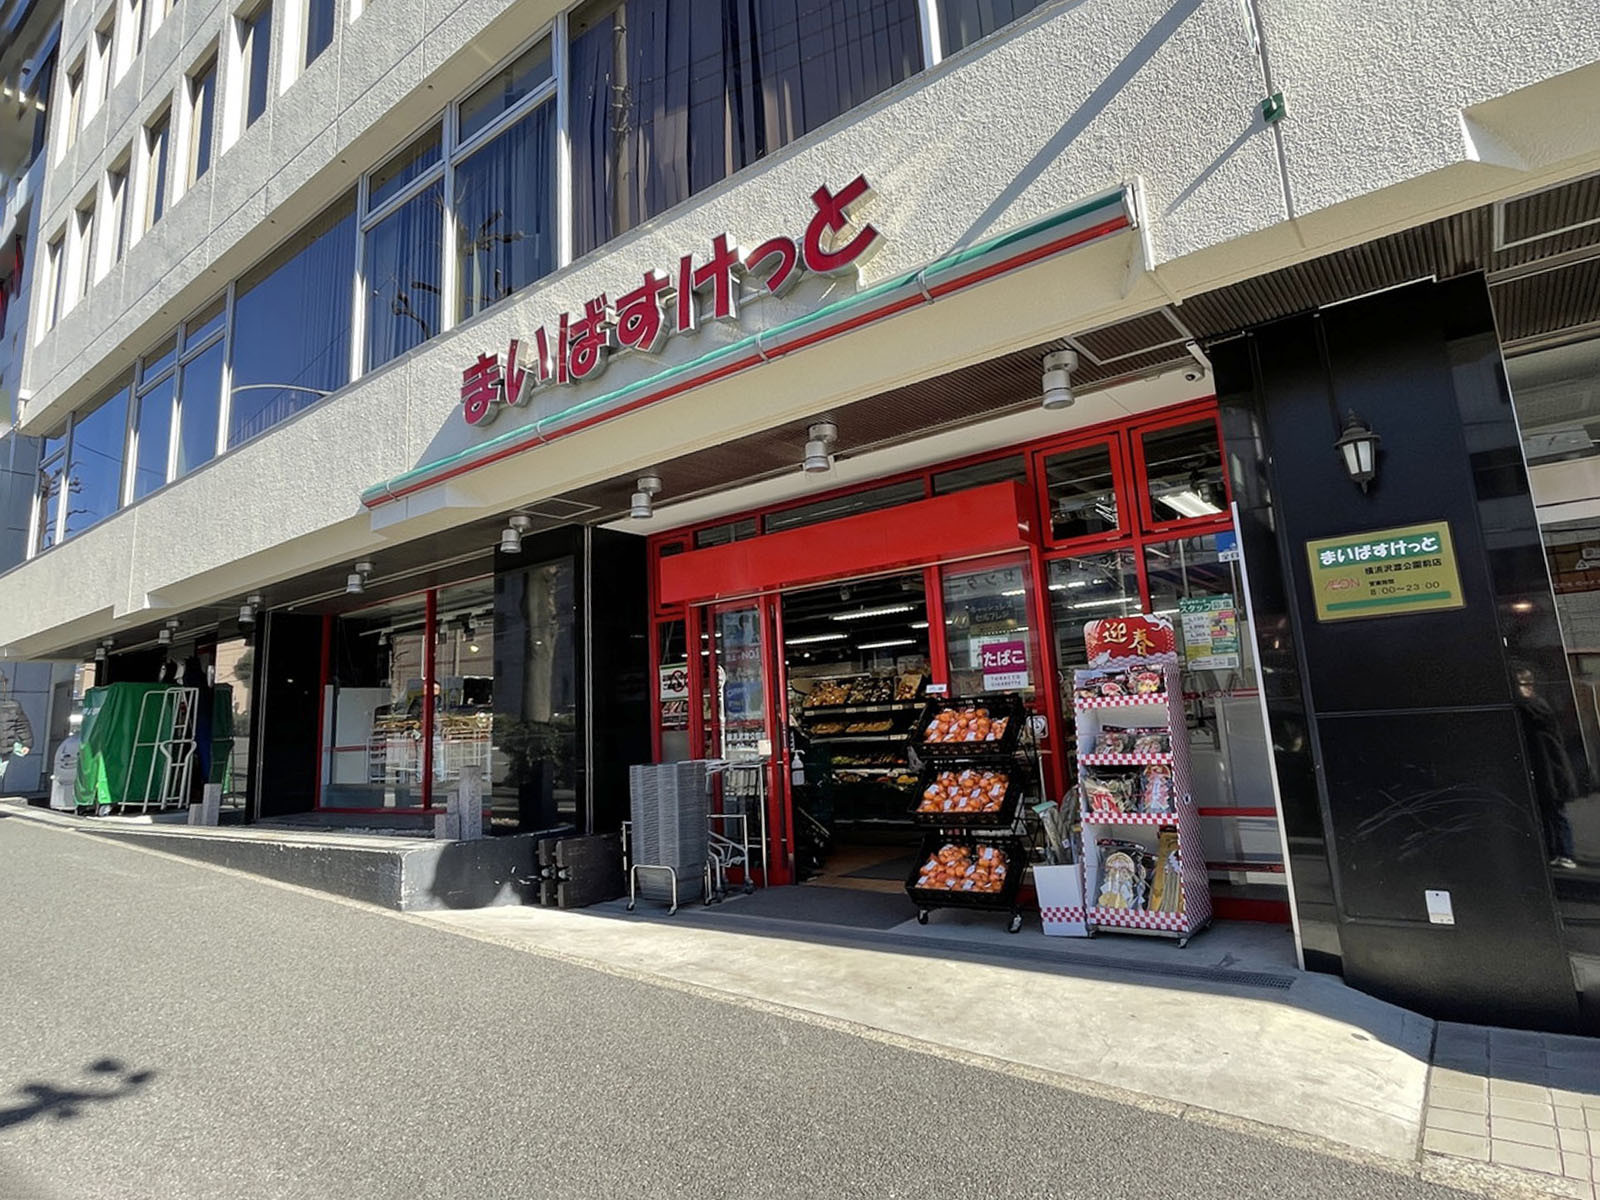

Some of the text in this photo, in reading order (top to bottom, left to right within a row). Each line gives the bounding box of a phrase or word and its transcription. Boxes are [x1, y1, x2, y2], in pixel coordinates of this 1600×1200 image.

[460, 173, 880, 428] まいばすけっと
[1320, 536, 1438, 566] まいばすけっと
[1102, 622, 1155, 656] 迎春
[983, 649, 1025, 667] たばこ
